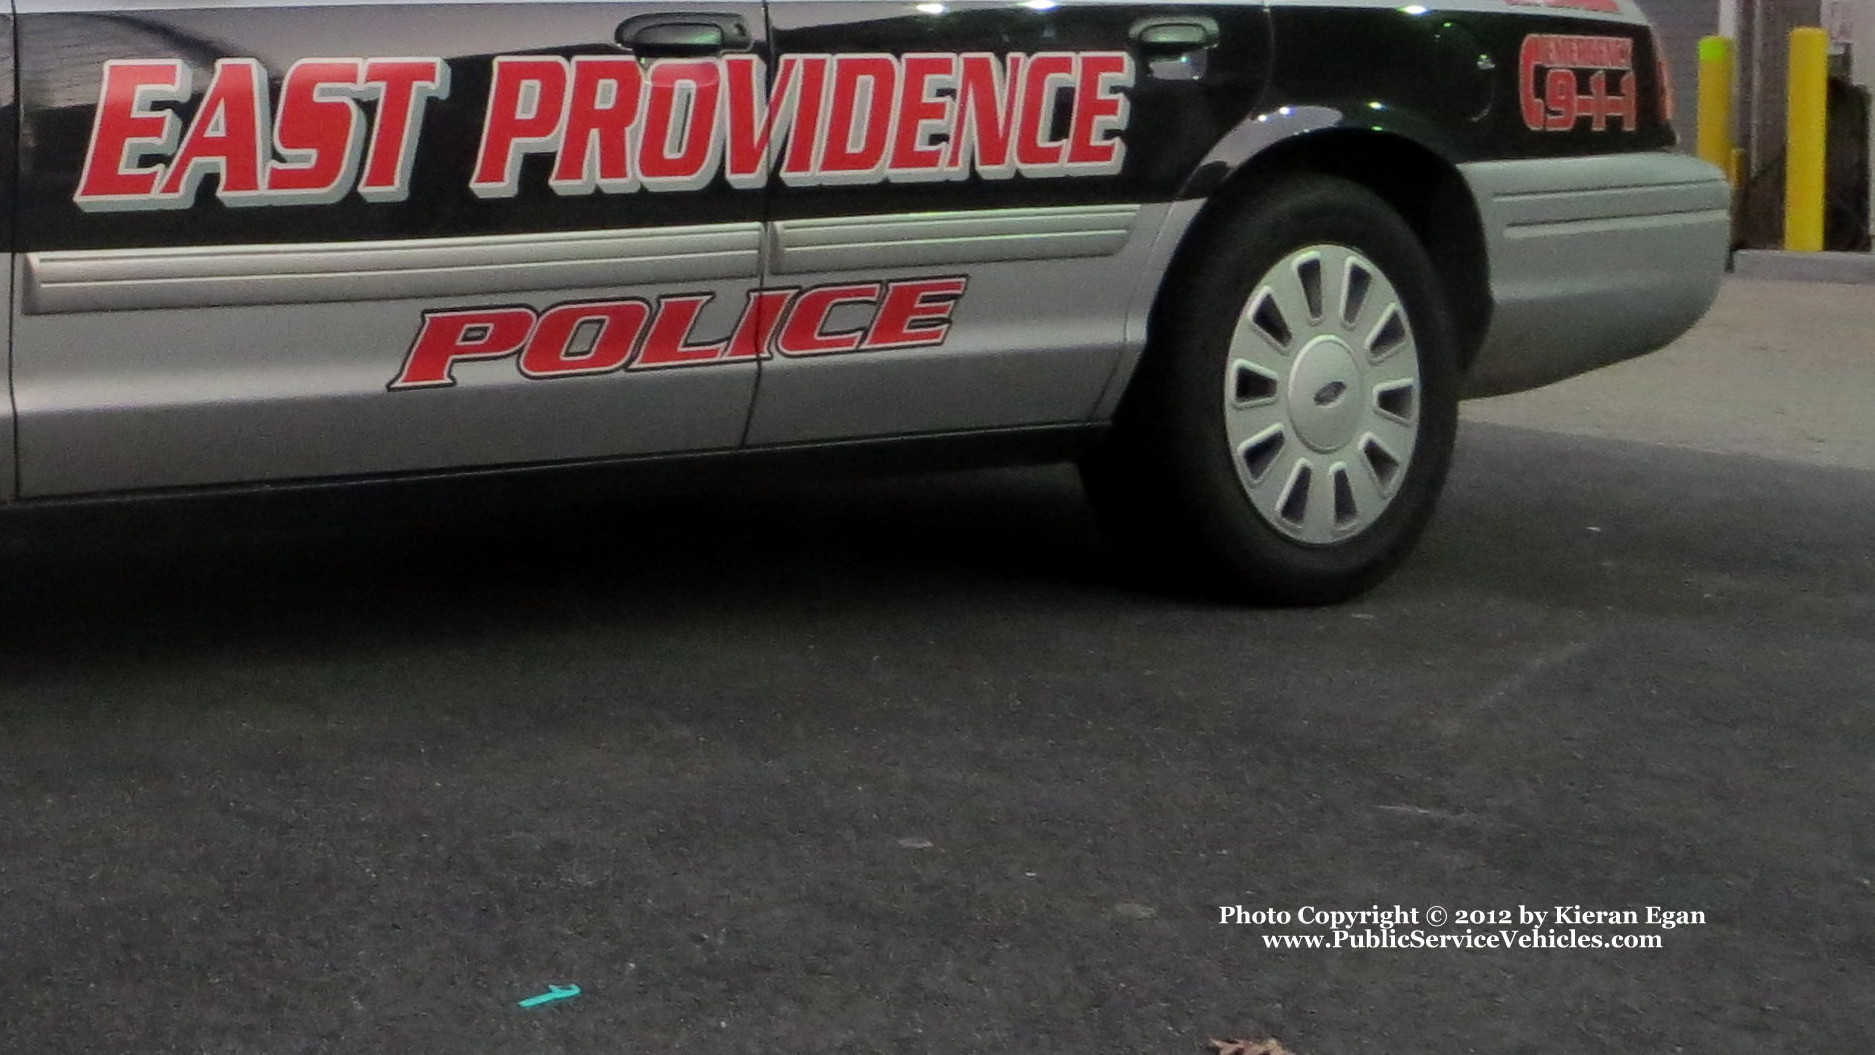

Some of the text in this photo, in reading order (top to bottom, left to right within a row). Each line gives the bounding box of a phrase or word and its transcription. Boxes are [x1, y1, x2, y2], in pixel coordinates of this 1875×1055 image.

[74, 52, 1134, 212] EAST PROVIDENCE
[387, 275, 967, 391] POLICE
